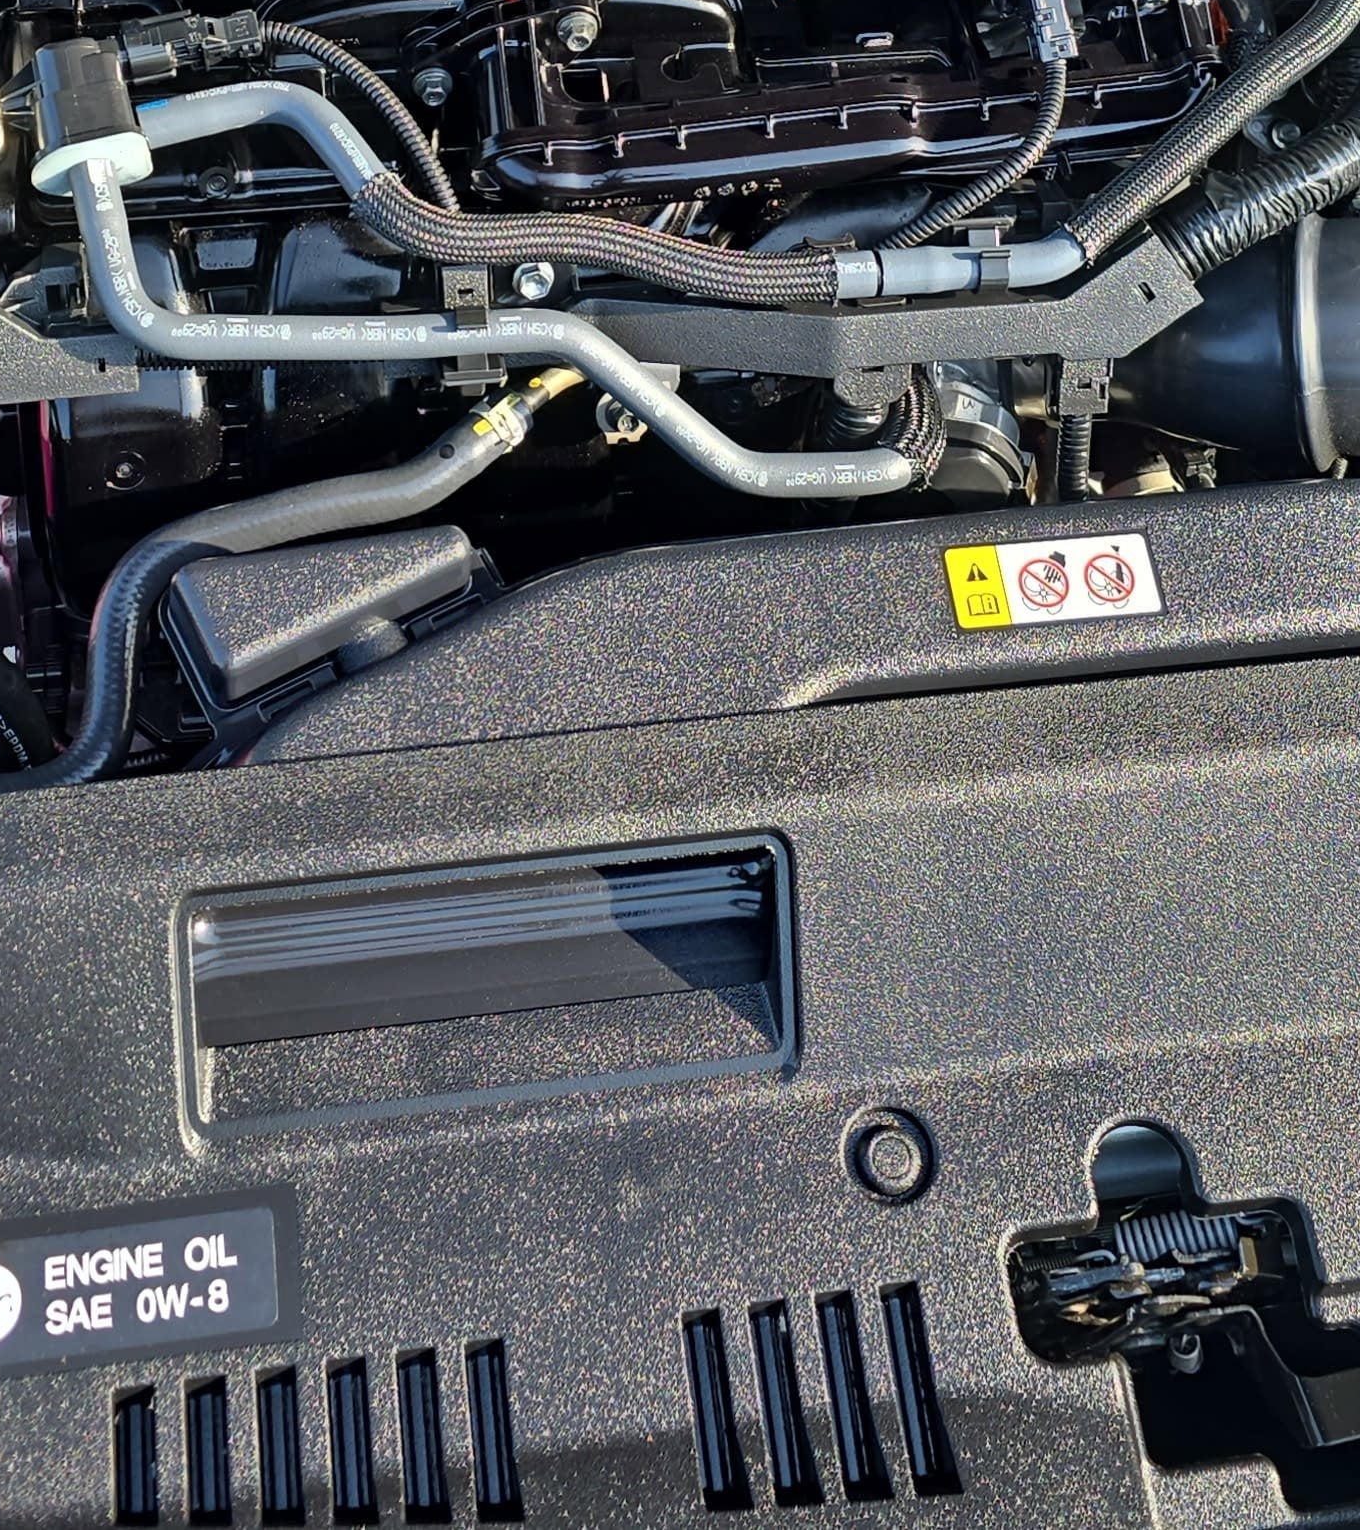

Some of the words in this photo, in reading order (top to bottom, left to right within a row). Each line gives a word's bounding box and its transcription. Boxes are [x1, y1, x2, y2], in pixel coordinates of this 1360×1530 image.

[44, 1241, 164, 1290] ENGINE
[183, 1233, 238, 1271] OIL
[44, 1293, 113, 1335] SAE
[136, 1278, 230, 1323] 0W-8
